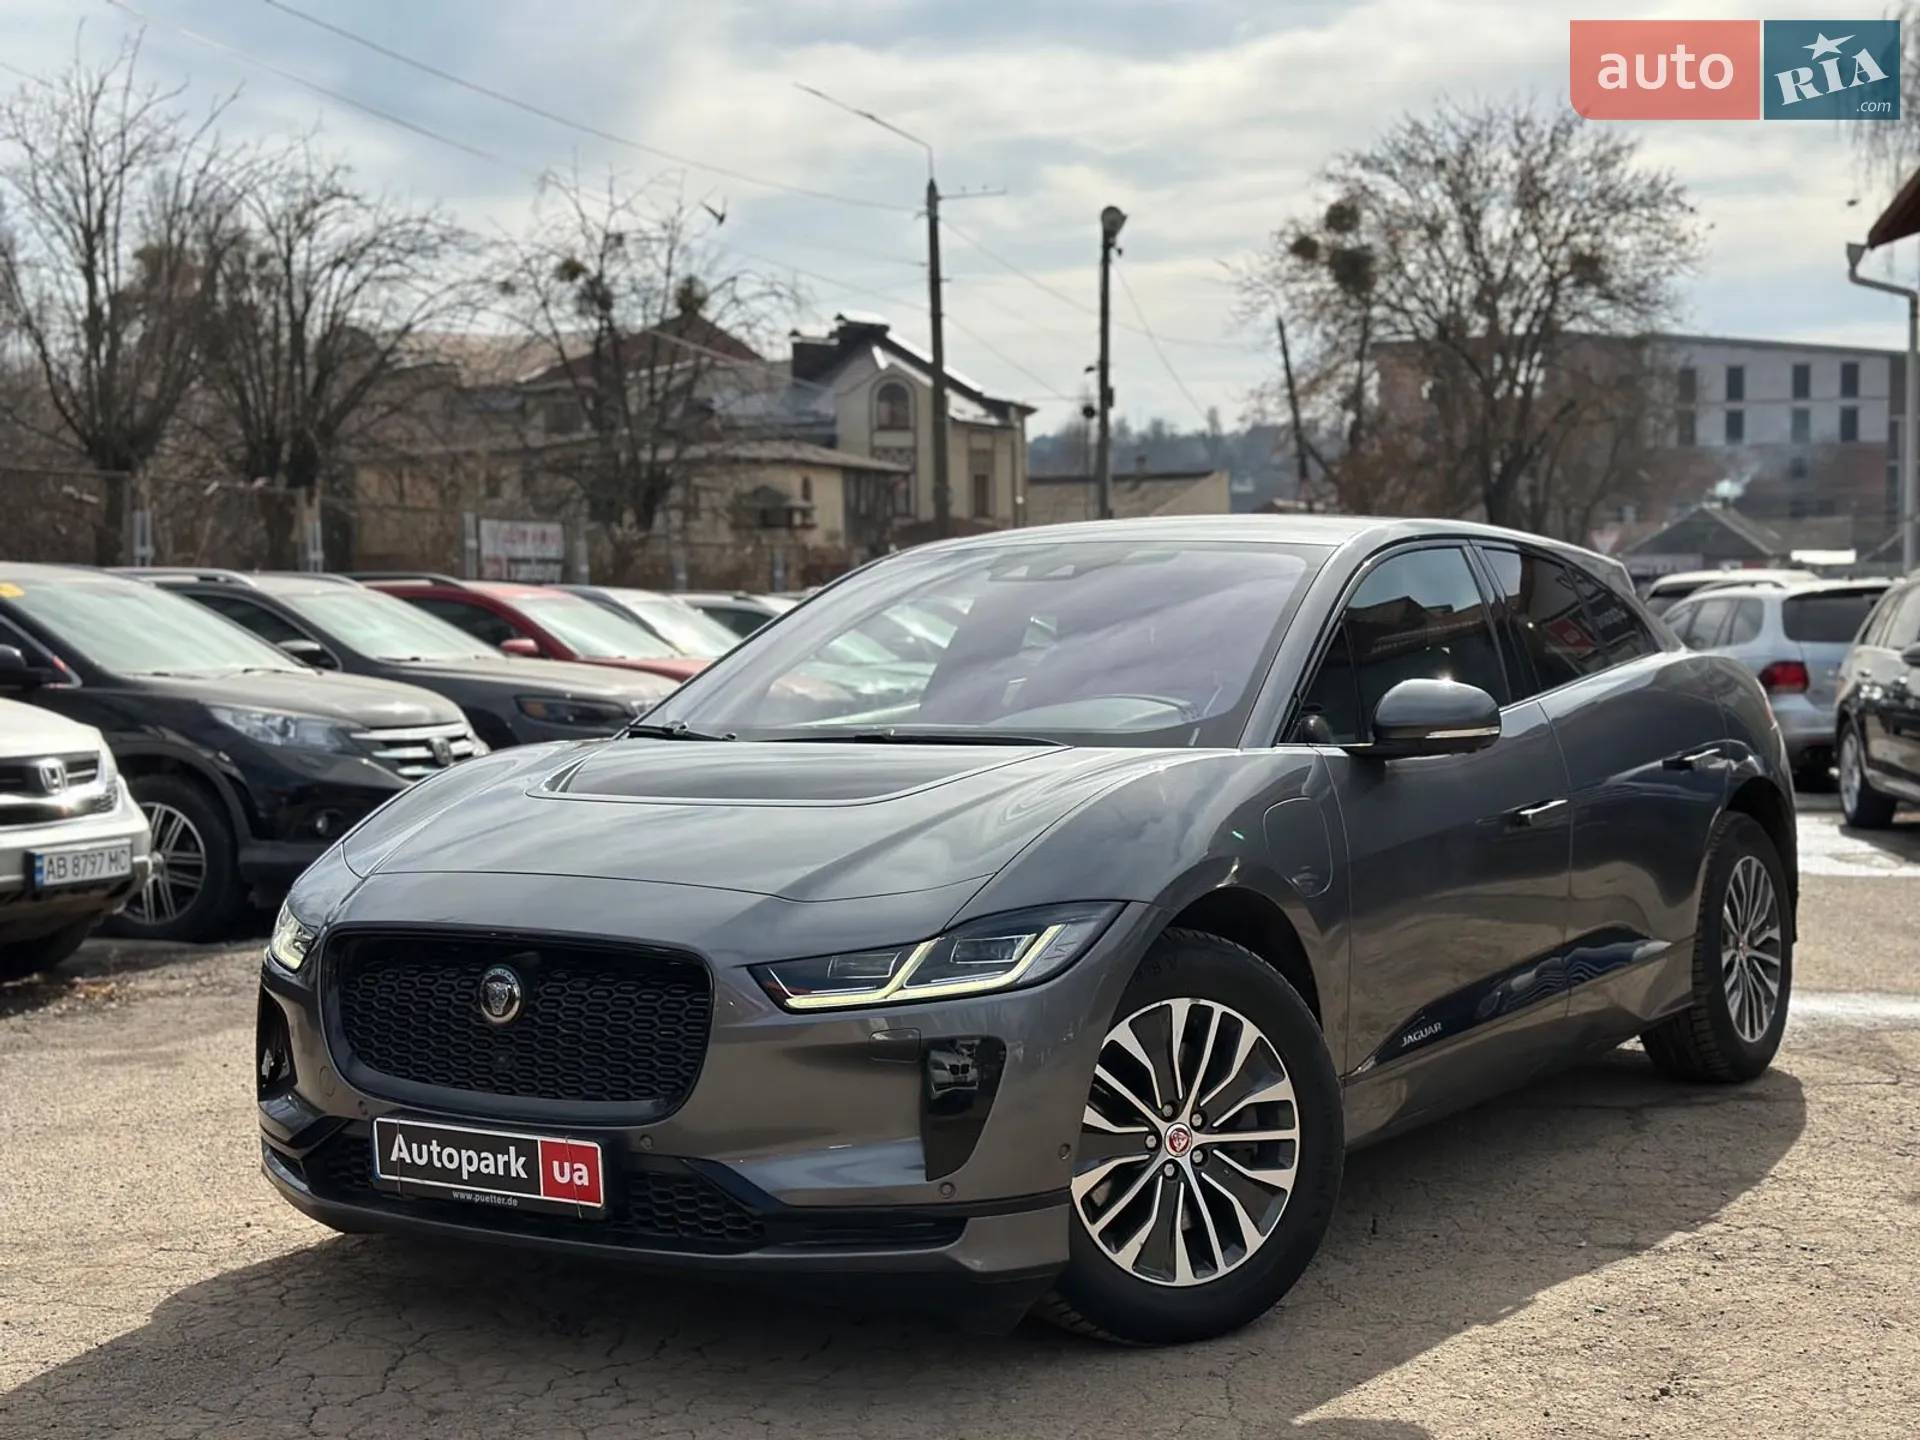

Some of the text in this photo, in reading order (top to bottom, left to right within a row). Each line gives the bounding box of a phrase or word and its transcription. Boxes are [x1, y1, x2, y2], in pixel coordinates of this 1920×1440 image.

[46, 856, 68, 881] AB
[72, 853, 105, 876] 8797
[1400, 1021, 1443, 1048] JAGUAR
[390, 1133, 589, 1187] Autopark ua
